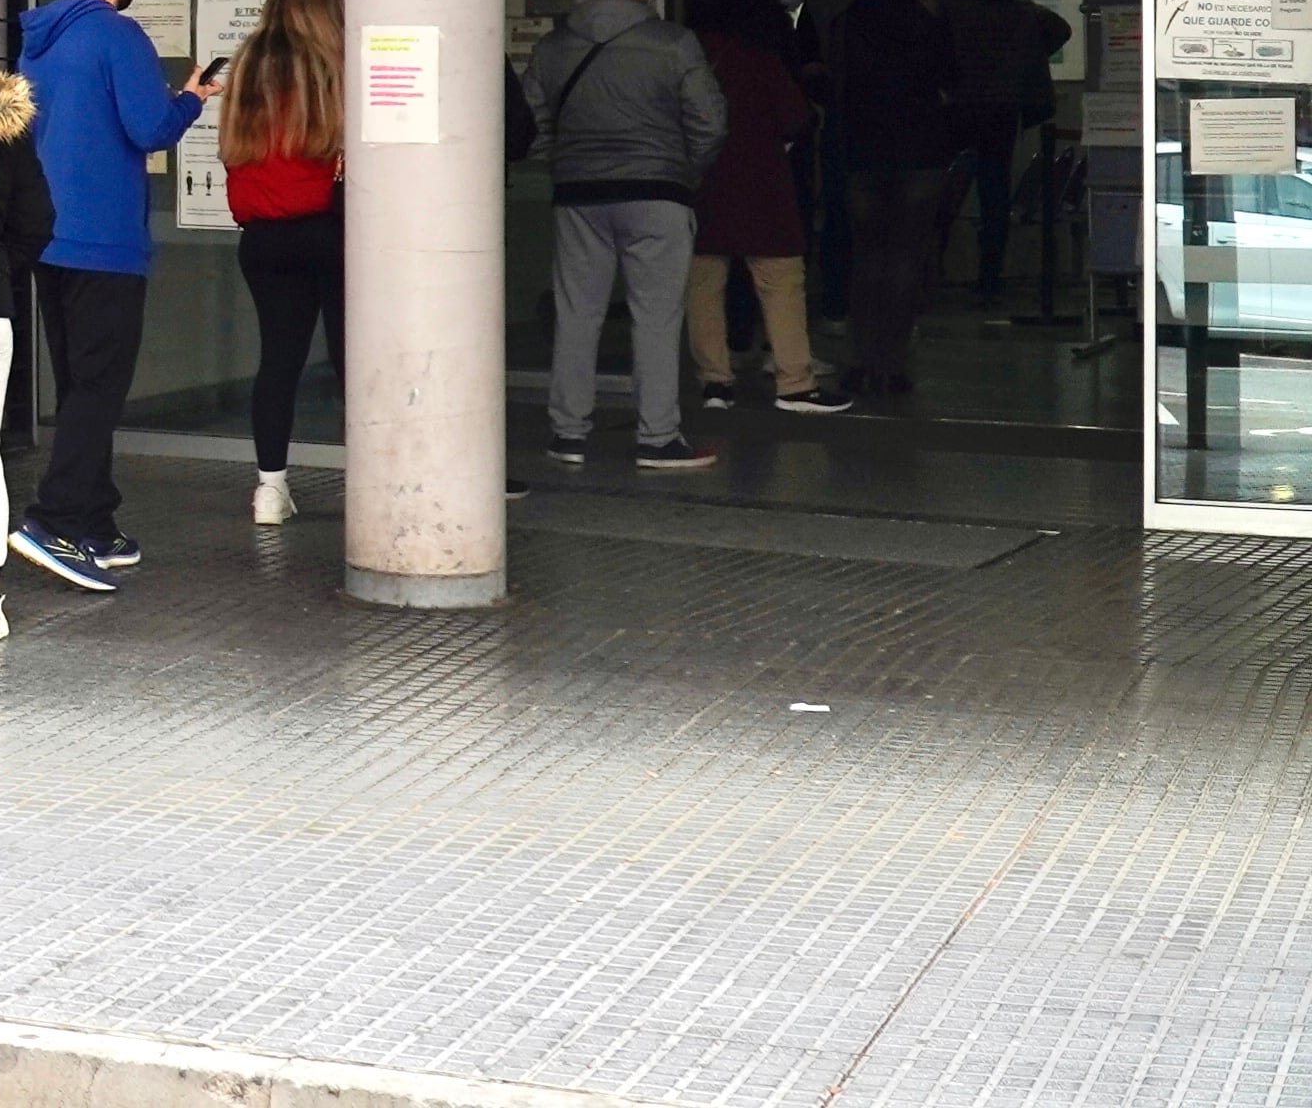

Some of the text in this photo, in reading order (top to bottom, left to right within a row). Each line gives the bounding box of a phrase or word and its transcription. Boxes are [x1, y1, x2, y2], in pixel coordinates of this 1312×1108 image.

[1197, 3, 1213, 11] NO
[1226, 4, 1272, 13] NECESARIO
[229, 20, 241, 28] NO
[1183, 16, 1271, 27] QUE GUARDE CO
[218, 32, 236, 41] QUE
